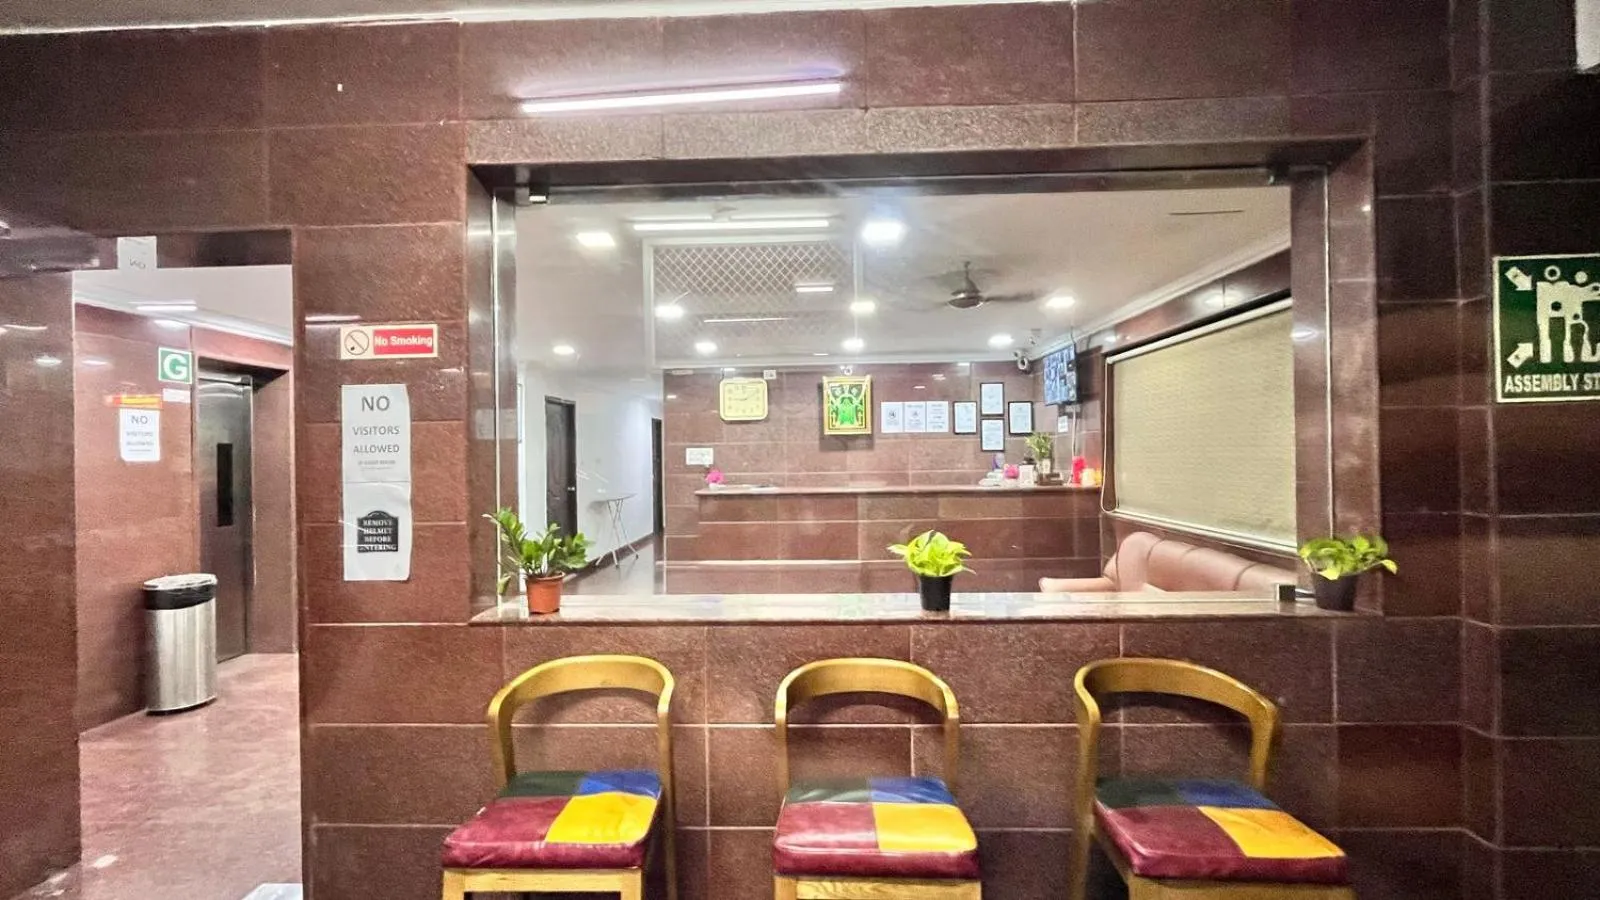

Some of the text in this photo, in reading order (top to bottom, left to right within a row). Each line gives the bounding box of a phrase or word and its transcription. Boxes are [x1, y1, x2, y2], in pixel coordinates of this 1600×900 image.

[375, 335, 433, 348] No Smoking
[163, 353, 188, 379] G
[1504, 374, 1580, 393] ASSEMBLY
[361, 395, 391, 412] NO
[131, 415, 148, 424] NO
[352, 426, 400, 436] VISITORS
[353, 444, 400, 454] ALLOWED
